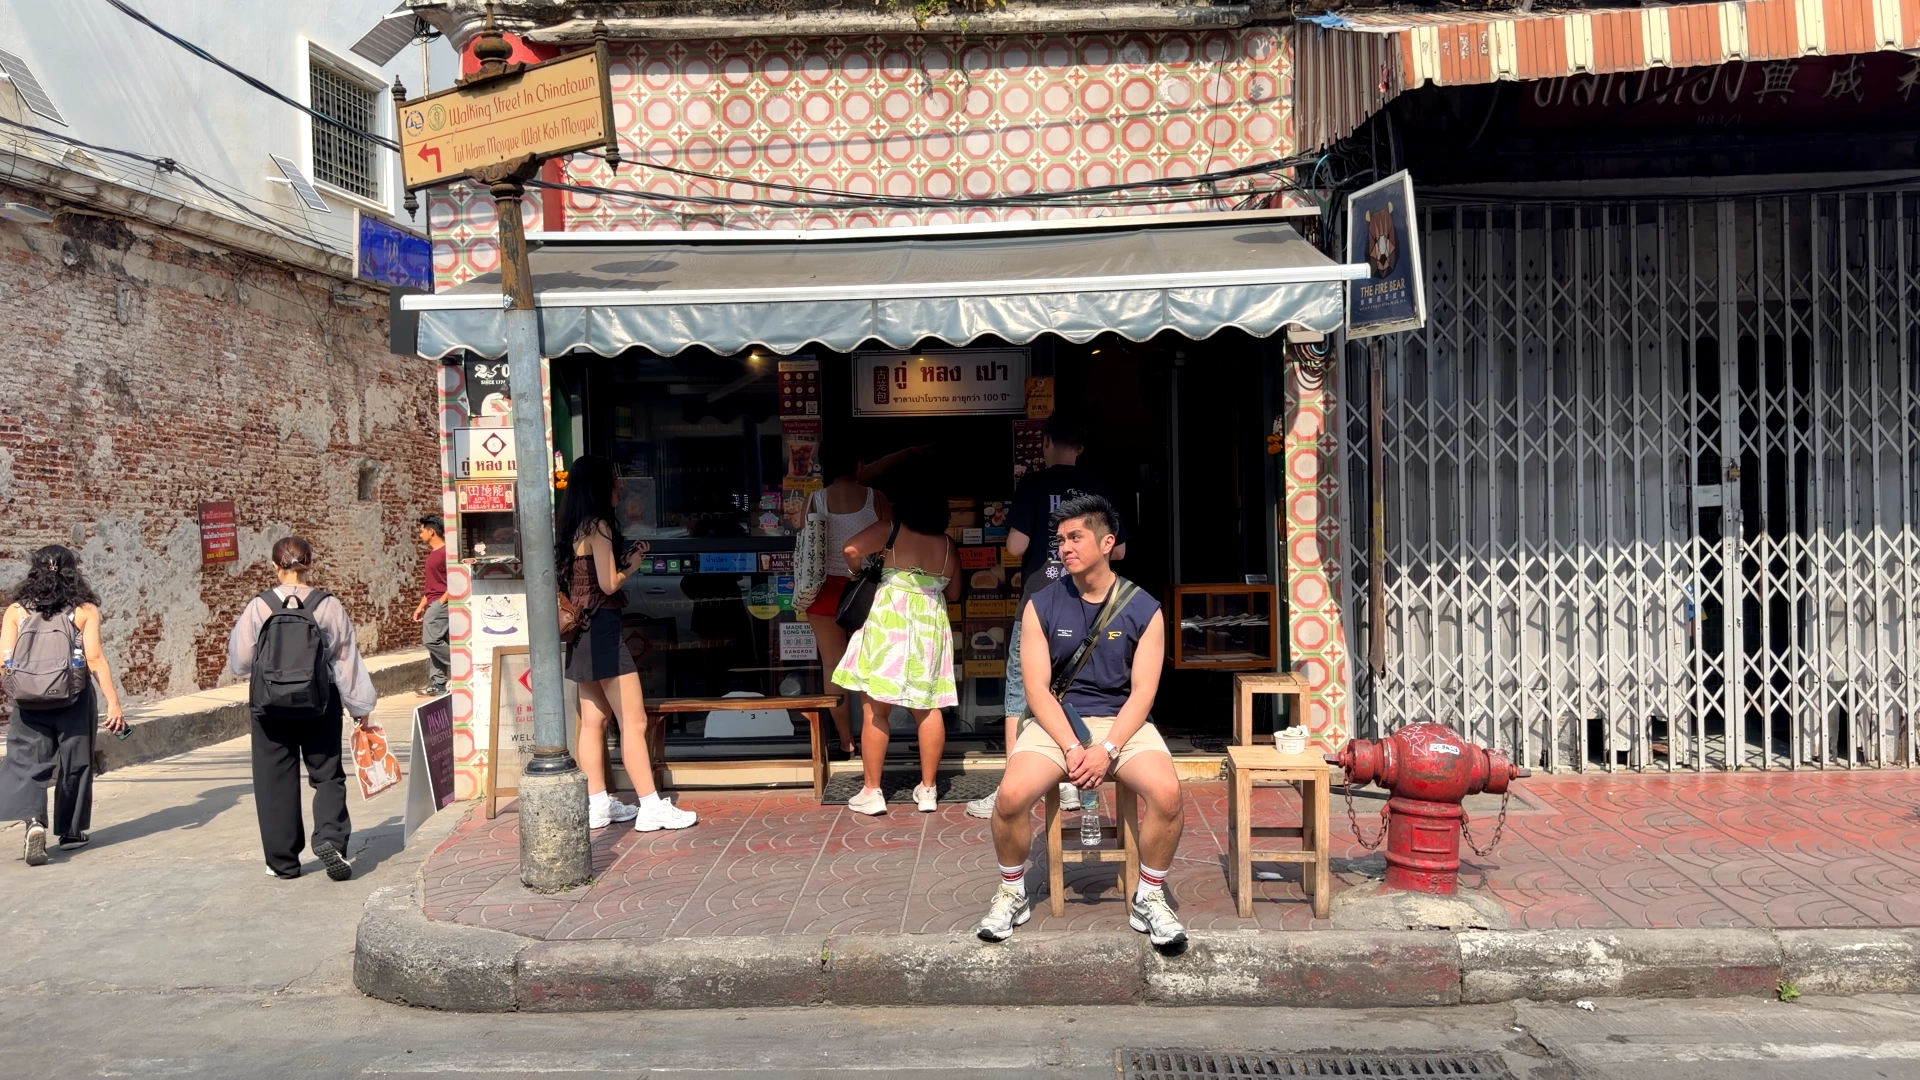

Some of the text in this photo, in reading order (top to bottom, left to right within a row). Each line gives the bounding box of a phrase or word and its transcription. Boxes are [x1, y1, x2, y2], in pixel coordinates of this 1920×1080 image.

[449, 104, 492, 127] Walking
[493, 92, 521, 114] Street
[523, 89, 534, 104] In
[536, 75, 596, 103] Chinatown
[487, 135, 519, 157] Mosque
[521, 129, 542, 147] (Wat
[543, 122, 559, 139] Koh
[560, 110, 599, 137] Mosque)
[1360, 285, 1374, 298] THE
[1374, 282, 1388, 295] FIRE
[1389, 278, 1406, 292] BEAR
[894, 361, 1008, 389] กู่ หลง เปา
[893, 393, 949, 403] ซาลาเปาโบราณ
[952, 392, 981, 404] อายุกว่า
[983, 393, 999, 401] 100
[475, 460, 503, 471] หลง
